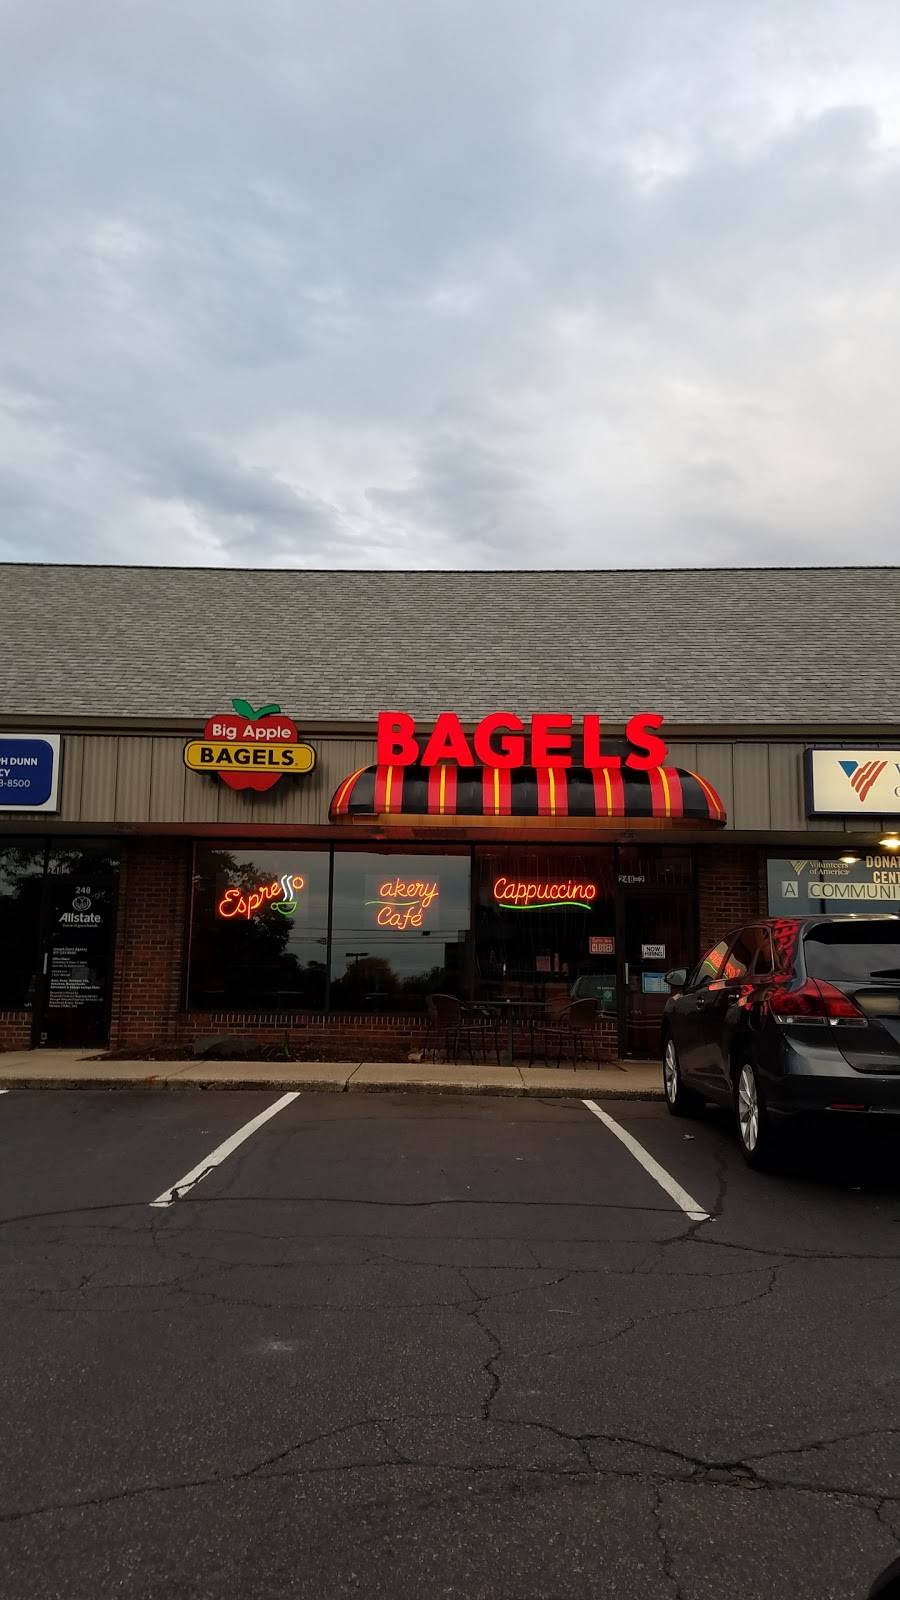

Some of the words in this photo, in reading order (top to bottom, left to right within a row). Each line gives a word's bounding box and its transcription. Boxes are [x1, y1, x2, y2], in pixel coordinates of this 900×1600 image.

[212, 724, 237, 740] Big
[243, 725, 292, 741] Apple
[377, 711, 669, 771] BAGELS
[9, 757, 38, 766] DUNN
[200, 747, 295, 767] BAGELS
[810, 861, 849, 869] Volunteers
[818, 868, 849, 876] America
[75, 886, 91, 894] 248
[494, 877, 596, 904] Cappuccino
[784, 883, 796, 896] A
[58, 912, 101, 923] Allstate
[377, 905, 423, 930] Café
